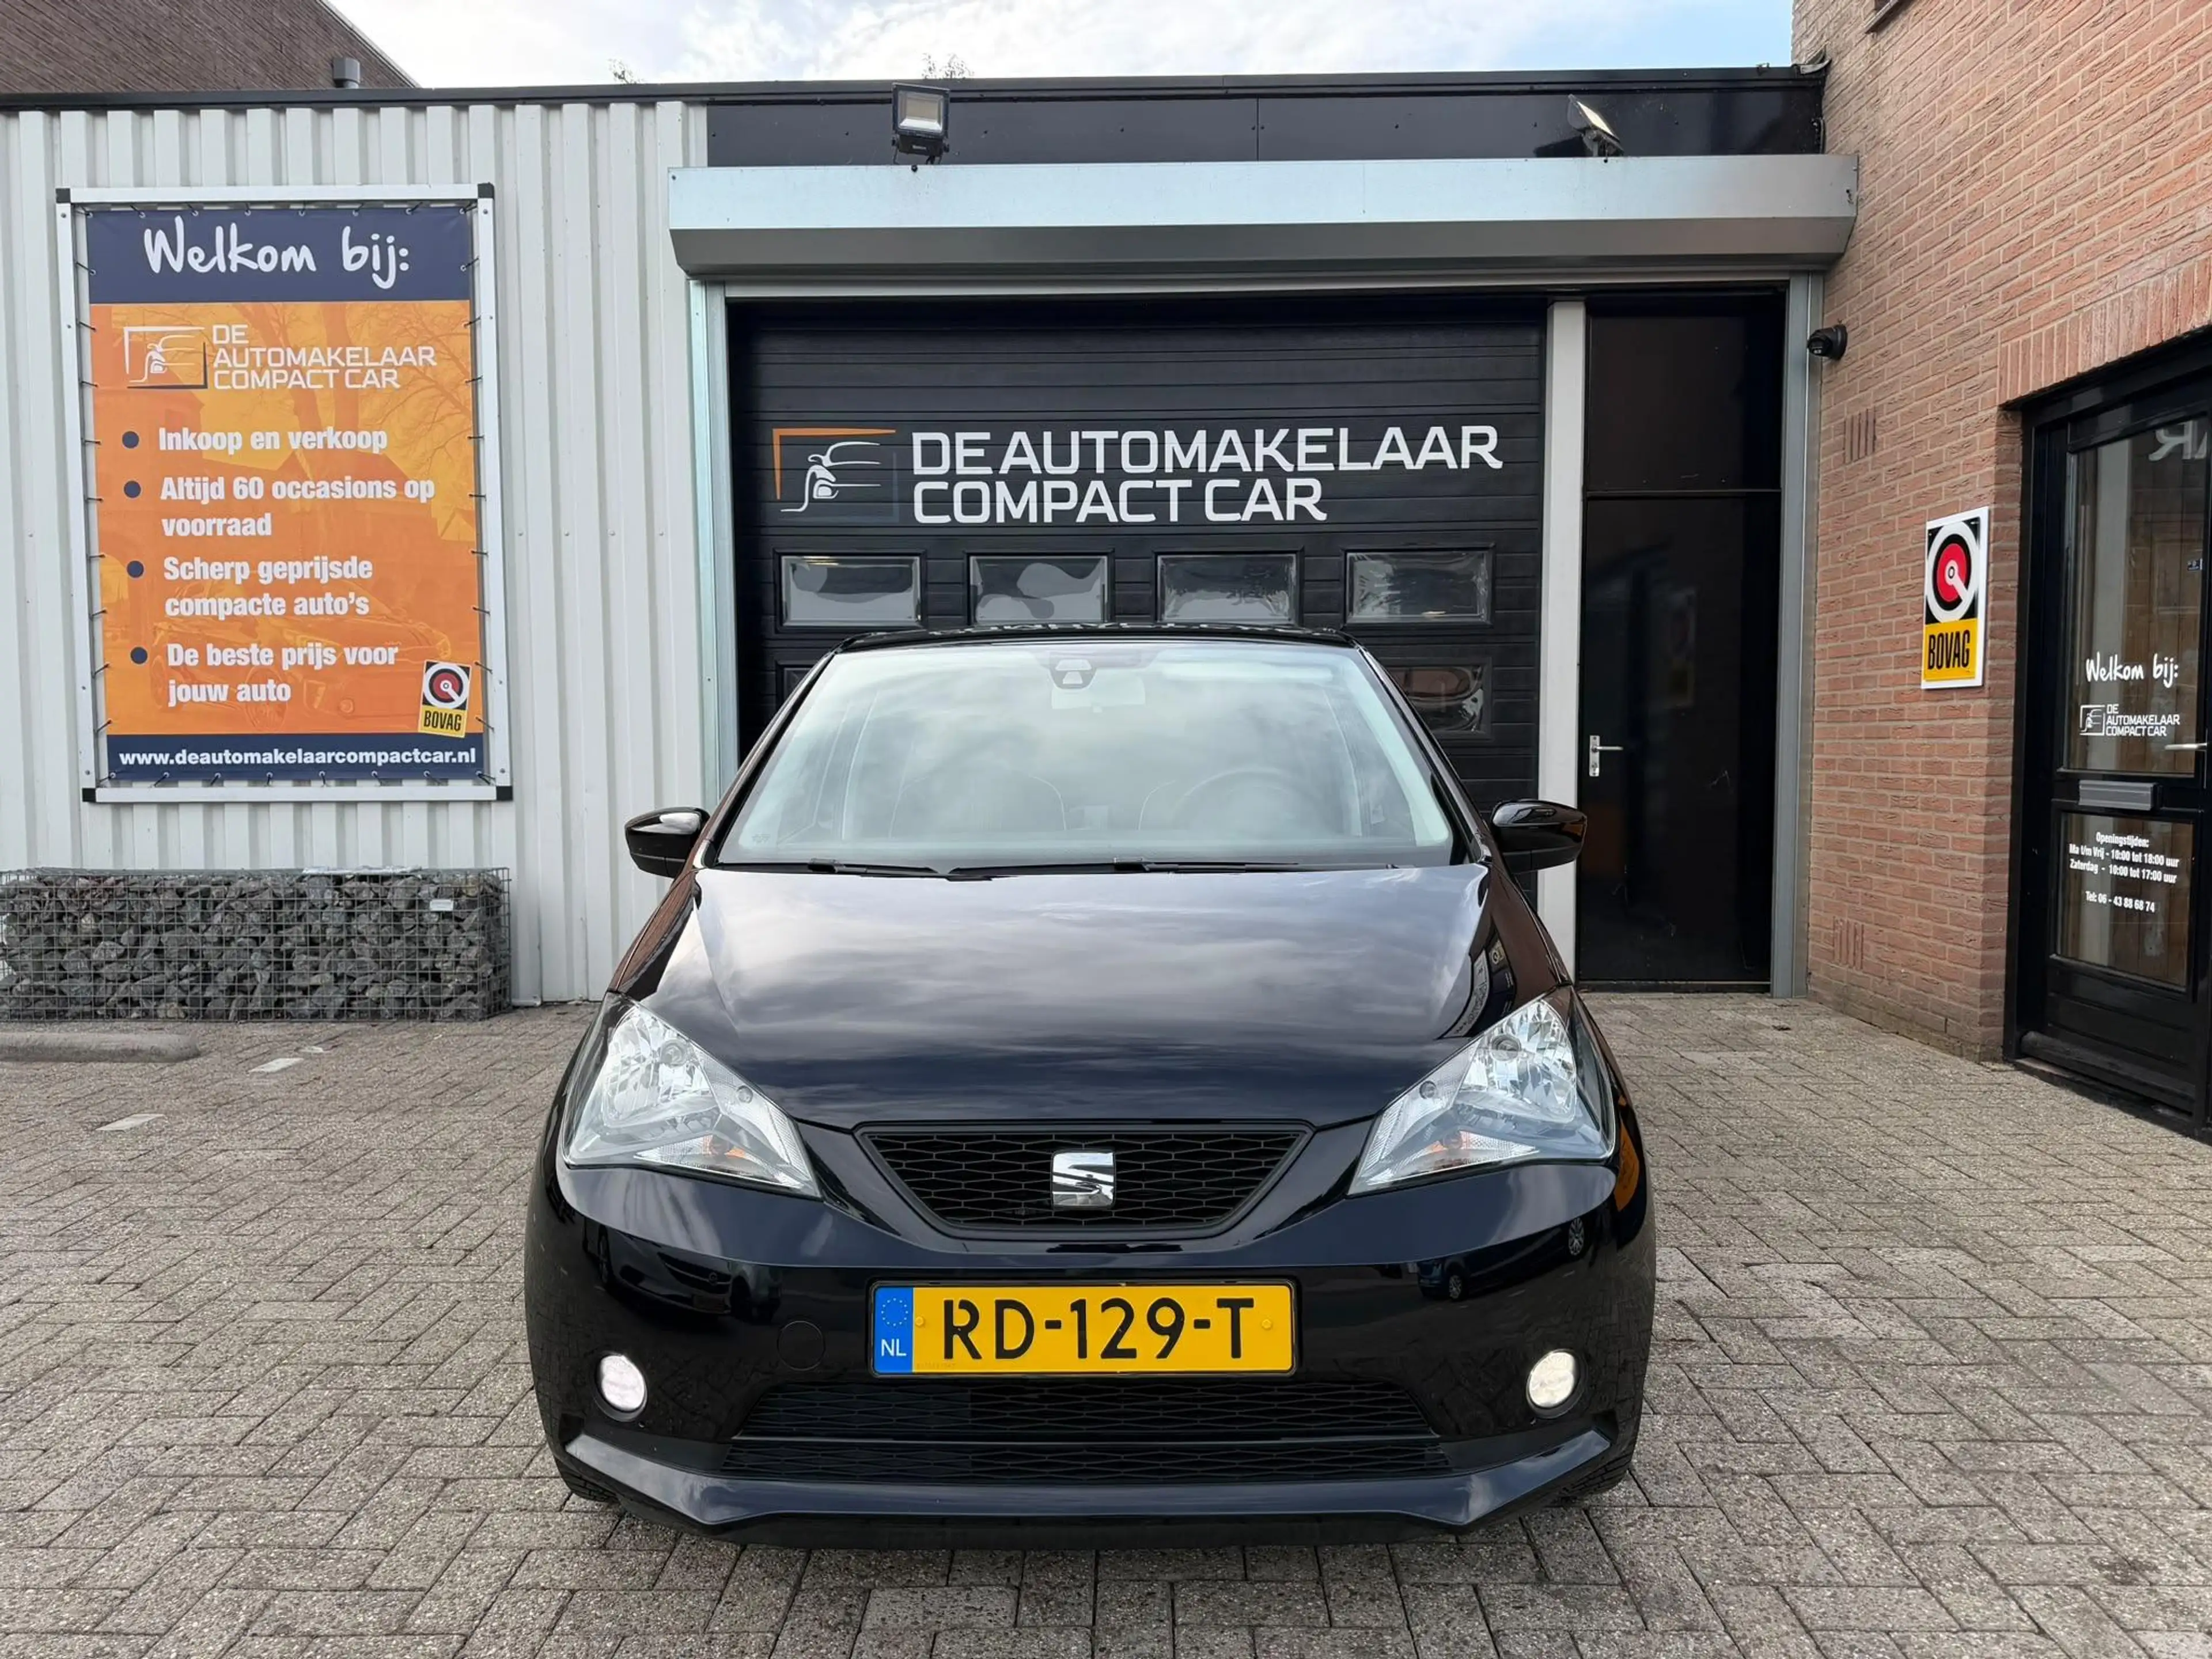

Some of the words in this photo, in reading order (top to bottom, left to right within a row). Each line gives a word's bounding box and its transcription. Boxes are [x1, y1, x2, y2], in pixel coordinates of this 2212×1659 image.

[143, 215, 316, 274] Welkom
[342, 226, 410, 289] bij:
[213, 324, 248, 344] DE
[213, 347, 437, 368] AUTOMAKELAAR
[214, 369, 339, 389] COMPACT
[344, 369, 400, 389] CAR
[158, 427, 242, 455] Inkoop
[250, 431, 280, 449] en
[288, 427, 387, 454] verkoop
[160, 476, 225, 506] Altijd
[233, 478, 264, 499] 60
[272, 476, 397, 499] occasions
[404, 480, 435, 503] op
[914, 479, 1192, 524] COMPACT
[1205, 478, 1327, 522] CAR
[162, 513, 272, 537] voorraad
[164, 556, 250, 582] Scherp
[257, 556, 373, 582] geprijsde
[165, 597, 286, 620] compacte
[294, 594, 370, 616] auto's
[167, 644, 198, 666] De
[207, 643, 274, 666] beste
[281, 644, 336, 671] prijs
[343, 645, 399, 665] voor
[1927, 629, 1970, 670] BOVAG
[2085, 651, 2145, 682] Welkom
[2153, 653, 2179, 688] bij:
[168, 681, 228, 708] jouw
[237, 680, 291, 702] auto
[423, 710, 462, 732] BOVAG
[2106, 714, 2180, 725] AUTOMAKELAAR
[2107, 704, 2119, 714] DE
[2106, 726, 2147, 736] COMPACT
[2147, 726, 2167, 736] CAR
[119, 747, 476, 767] www.deautomakelaarcompactcar.nl
[2096, 831, 2150, 848] Openingstijden:
[2093, 847, 2104, 859] Vrij
[2132, 851, 2142, 863] tot
[2165, 858, 2180, 868] uur
[2069, 859, 2099, 874] Zaterdag
[2130, 867, 2139, 878] tot
[2141, 869, 2162, 882] 17:00
[2163, 873, 2177, 884] uur
[2113, 896, 2122, 907] 43
[2145, 902, 2155, 913] 74
[880, 1338, 907, 1358] NL
[942, 1296, 1255, 1360] RD-129-T
